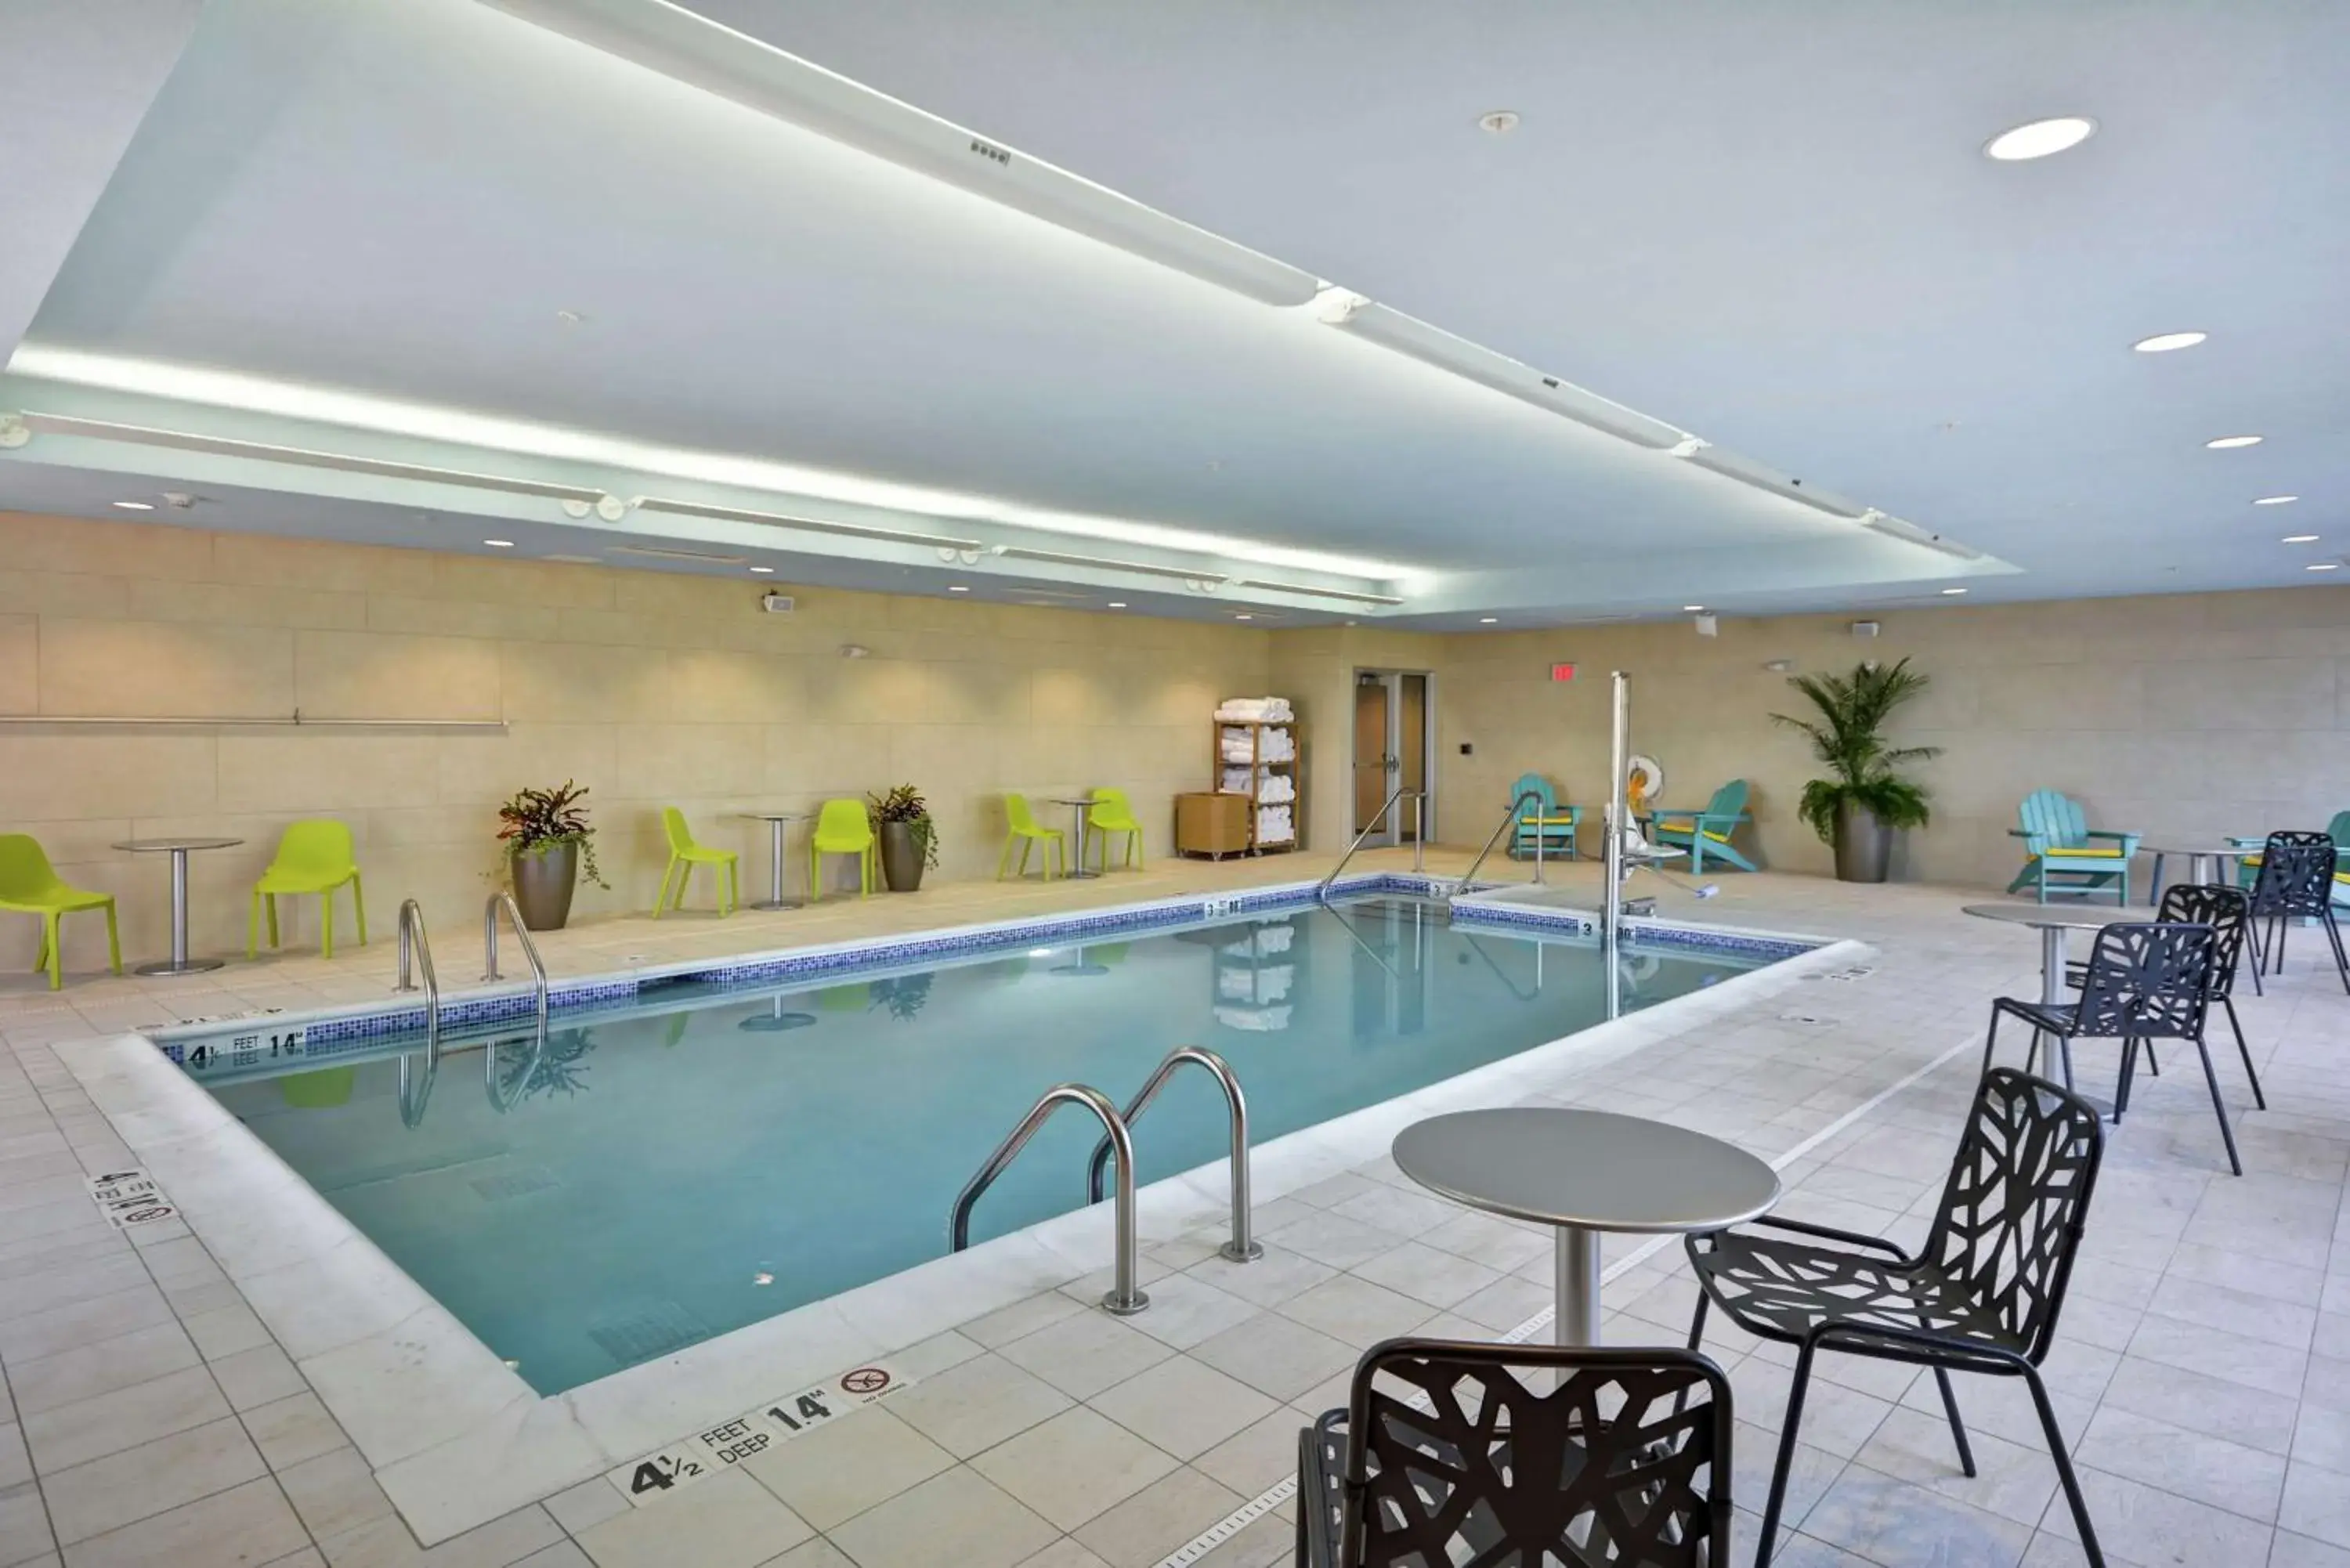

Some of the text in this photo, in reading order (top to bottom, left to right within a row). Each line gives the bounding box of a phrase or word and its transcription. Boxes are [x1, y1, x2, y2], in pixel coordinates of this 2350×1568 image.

[233, 1035, 259, 1050] FEET
[700, 1418, 752, 1447] FEET
[716, 1434, 771, 1465] DEEP
